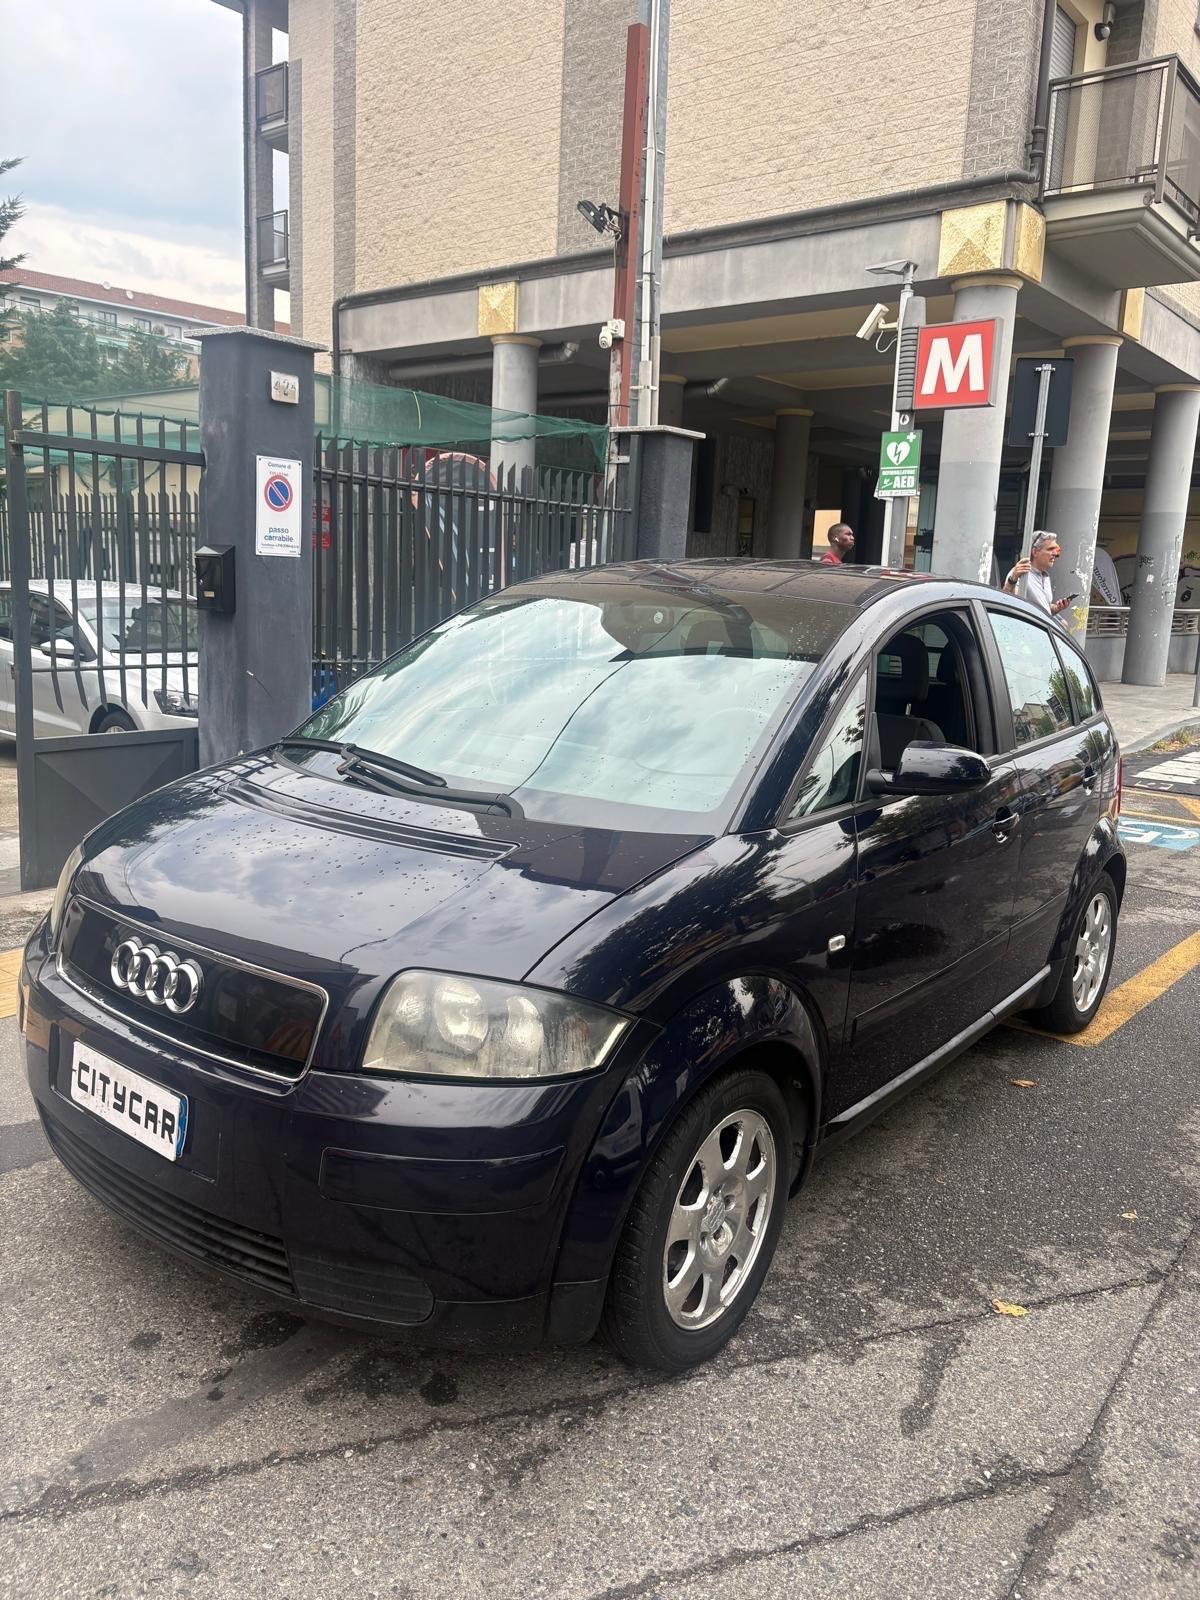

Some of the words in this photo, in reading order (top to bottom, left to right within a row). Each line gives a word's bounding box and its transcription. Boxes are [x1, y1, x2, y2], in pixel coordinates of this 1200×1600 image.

[920, 333, 985, 395] M
[892, 475, 915, 489] AED
[263, 534, 294, 543] carrabile
[77, 1061, 176, 1145] CITYCAR
